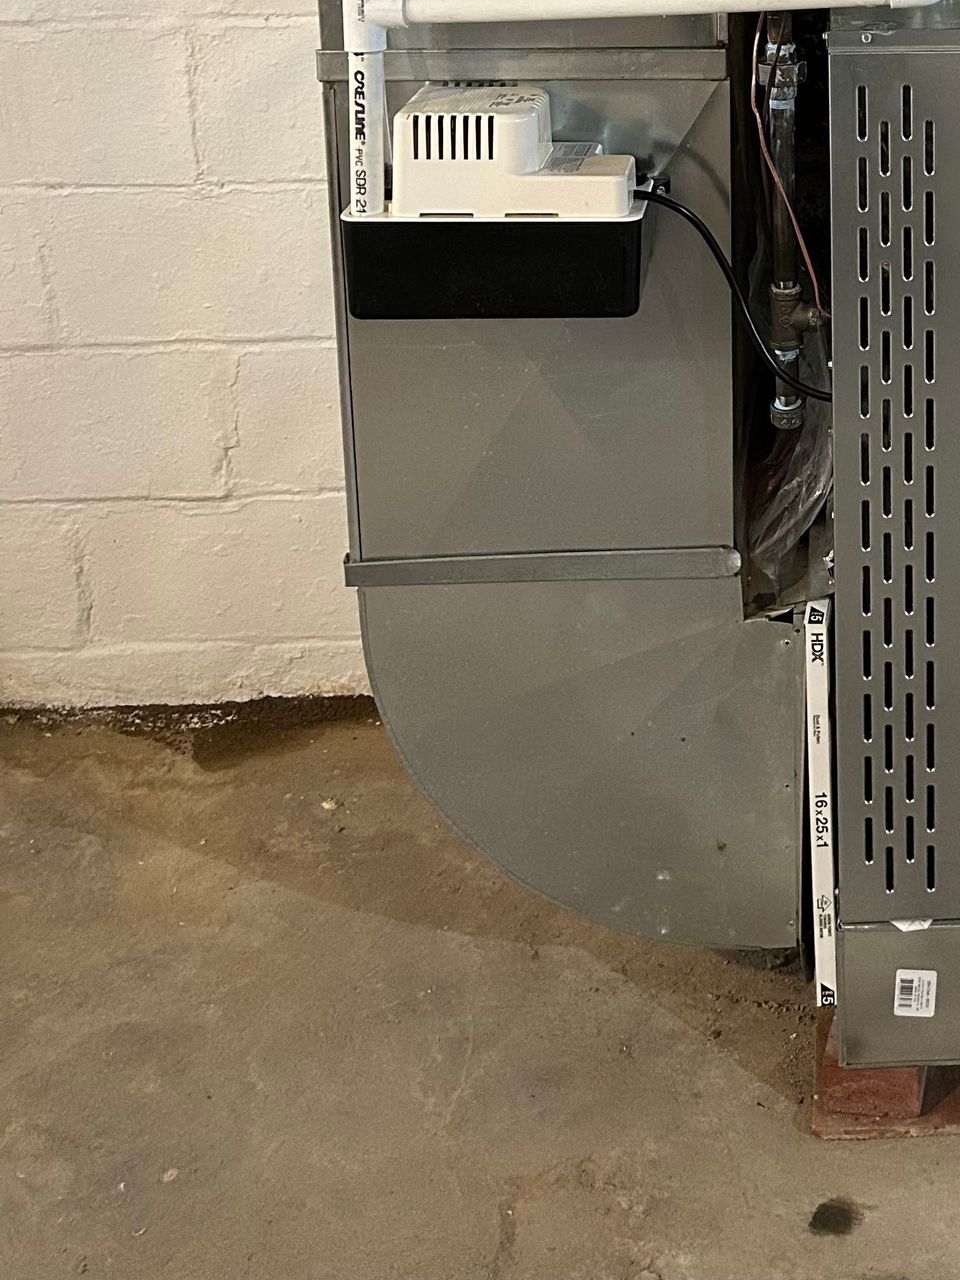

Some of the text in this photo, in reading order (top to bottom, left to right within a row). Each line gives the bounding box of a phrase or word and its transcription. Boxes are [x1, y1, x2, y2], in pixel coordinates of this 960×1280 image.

[355, 148, 364, 167] PVC
[355, 170, 367, 196] SDR
[356, 199, 367, 215] 21
[811, 633, 824, 663] HDX
